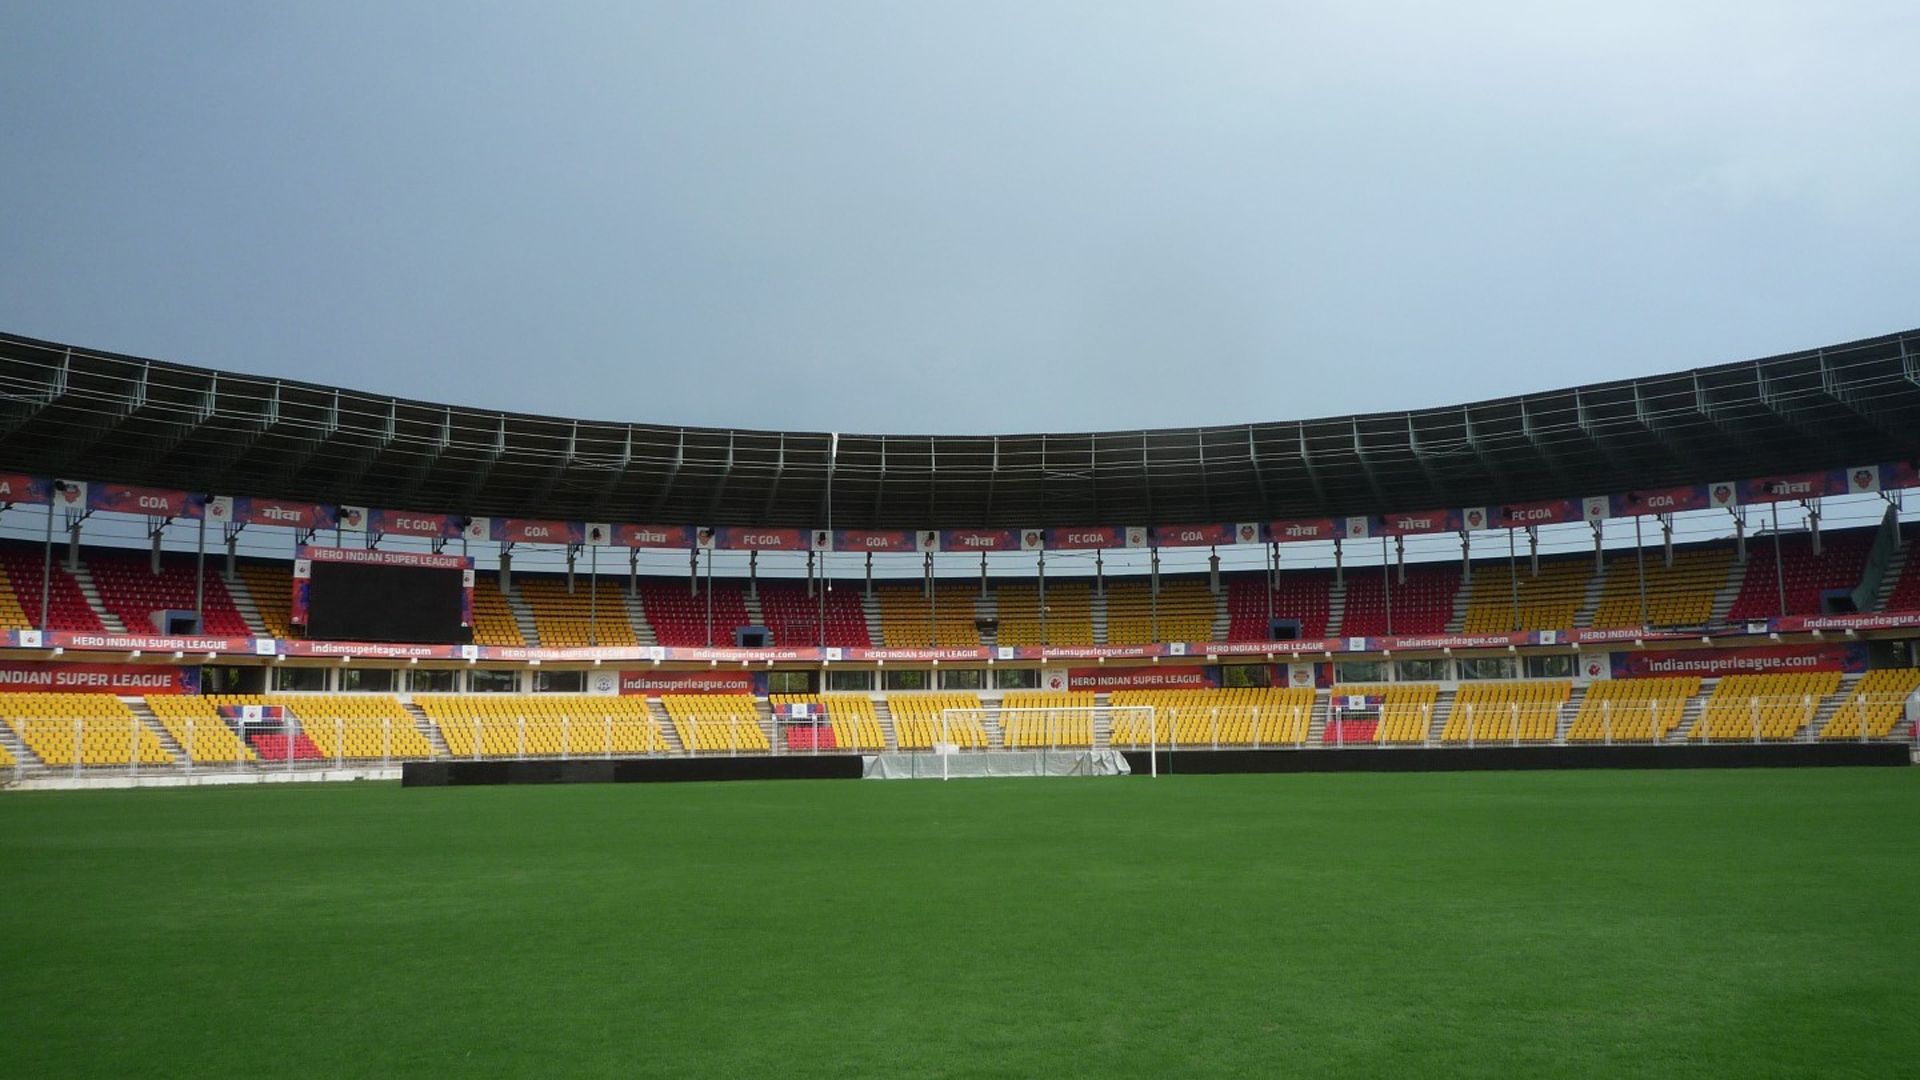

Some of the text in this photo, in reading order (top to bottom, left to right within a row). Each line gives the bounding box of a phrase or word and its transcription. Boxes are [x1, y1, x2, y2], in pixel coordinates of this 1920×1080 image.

[139, 495, 169, 510] GOA
[1648, 496, 1674, 507] GOA
[262, 505, 302, 522] गोवा
[1511, 509, 1552, 521] FC GOA
[396, 518, 438, 531] FC GOA
[1398, 517, 1432, 530] गोवा
[524, 526, 549, 537] GOA
[1181, 531, 1203, 541] GOA
[1285, 524, 1318, 536] गोवा
[634, 531, 667, 543] गोवा
[743, 535, 781, 546] FC GOA
[866, 537, 888, 547] GOA
[964, 535, 995, 547] गोवा
[1068, 533, 1104, 544] FC GOA
[314, 549, 458, 568] HERO INDIAN SUPER LEAGUE
[1396, 634, 1509, 648] indiansuperleague.com
[1580, 631, 1606, 640] HERO
[1608, 630, 1642, 639] INDIAN
[72, 636, 227, 650] HERO INDIAN SUPER LEAGUE
[1206, 642, 1324, 653] HERO INDIAN SUPER LEAGUE
[312, 643, 432, 658] indiansuperleague.com
[502, 650, 624, 659] HERO INDIAN SUPER LEAGUE
[692, 649, 796, 660] indiansuperleague.com
[864, 649, 978, 658] HERO INDIAN SUPER LEAGUE
[1042, 647, 1144, 658] indiansuperleague.com
[1650, 654, 1817, 672] indiansuperleague.com
[56, 672, 108, 686] SUPER
[112, 674, 172, 687] LEAGUE
[623, 678, 748, 691] indiansuperleague.com
[1070, 674, 1201, 686] HERO INDIAN SUPER LEAGUE
